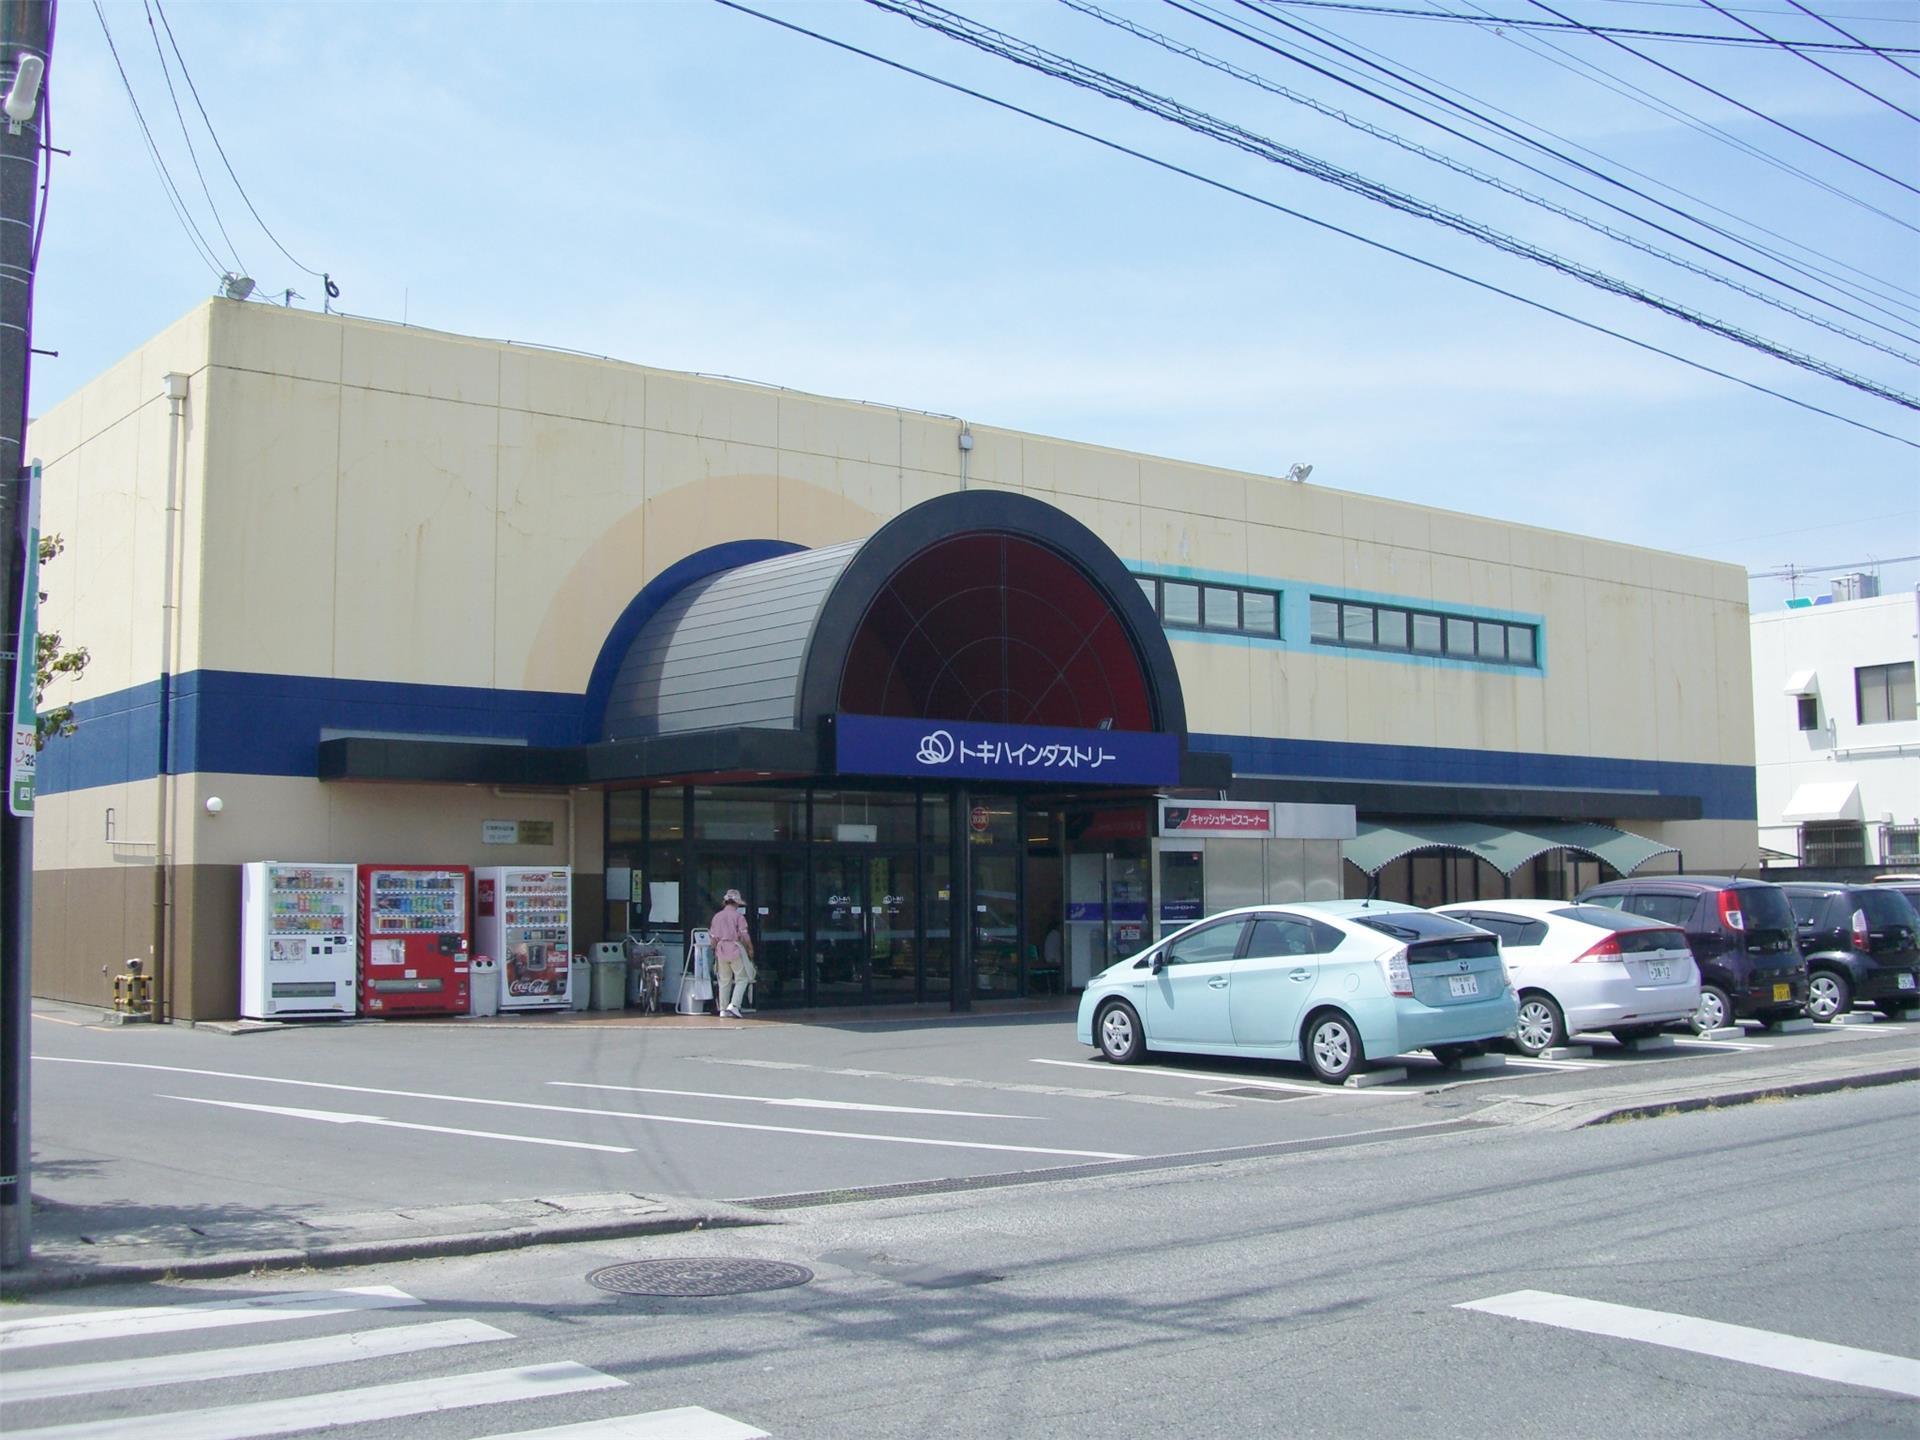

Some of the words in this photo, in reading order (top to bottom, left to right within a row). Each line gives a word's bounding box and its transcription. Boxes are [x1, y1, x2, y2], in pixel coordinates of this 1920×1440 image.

[960, 740, 1116, 768] トキハインダストリー
[1191, 814, 1266, 826] キャッシュサービスコーナー
[510, 979, 549, 994] Coca-Cola
